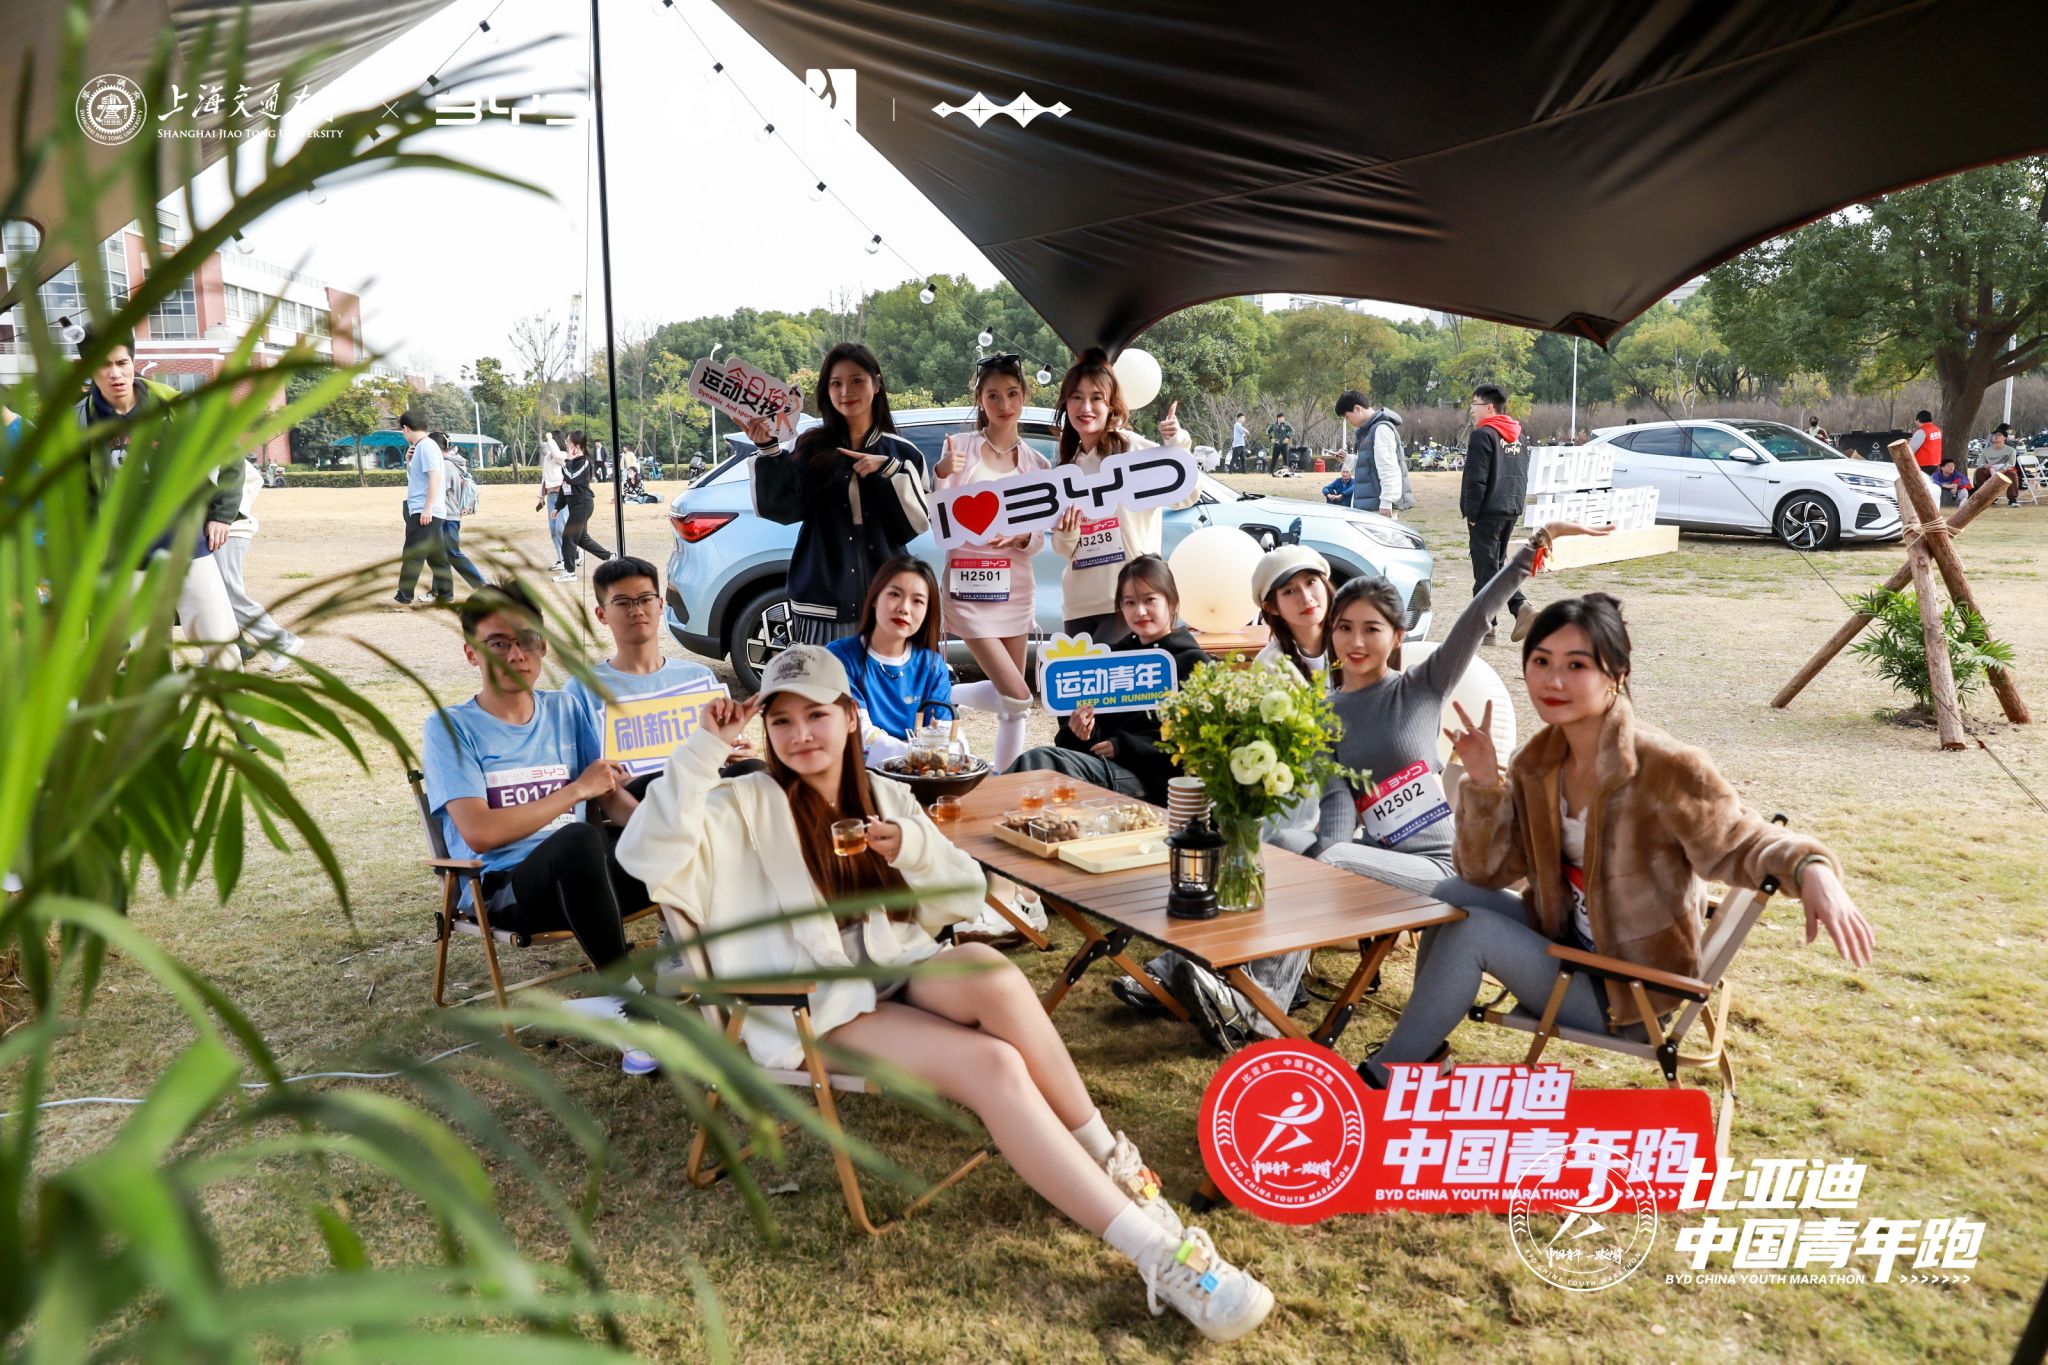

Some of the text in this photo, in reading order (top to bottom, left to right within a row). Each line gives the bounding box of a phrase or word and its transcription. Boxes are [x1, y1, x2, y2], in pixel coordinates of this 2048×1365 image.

[937, 458, 1186, 539] I BYD
[960, 571, 1000, 581] H2501
[1055, 663, 1162, 699] 运动青年
[1076, 691, 1165, 708] KEEP ON RUNNING
[614, 704, 706, 752] 刷新记
[531, 767, 566, 779] BYD
[1388, 765, 1423, 789] BYD
[1373, 782, 1425, 821] H2502
[1383, 1065, 1572, 1121] 比亚迪
[1383, 1128, 1698, 1198] 中国青年跑
[1274, 1194, 1305, 1203] YOUTH
[1308, 1165, 1350, 1200] MARATHON
[1375, 1189, 1579, 1200] BYD CHINA YOUTH MARATHON
